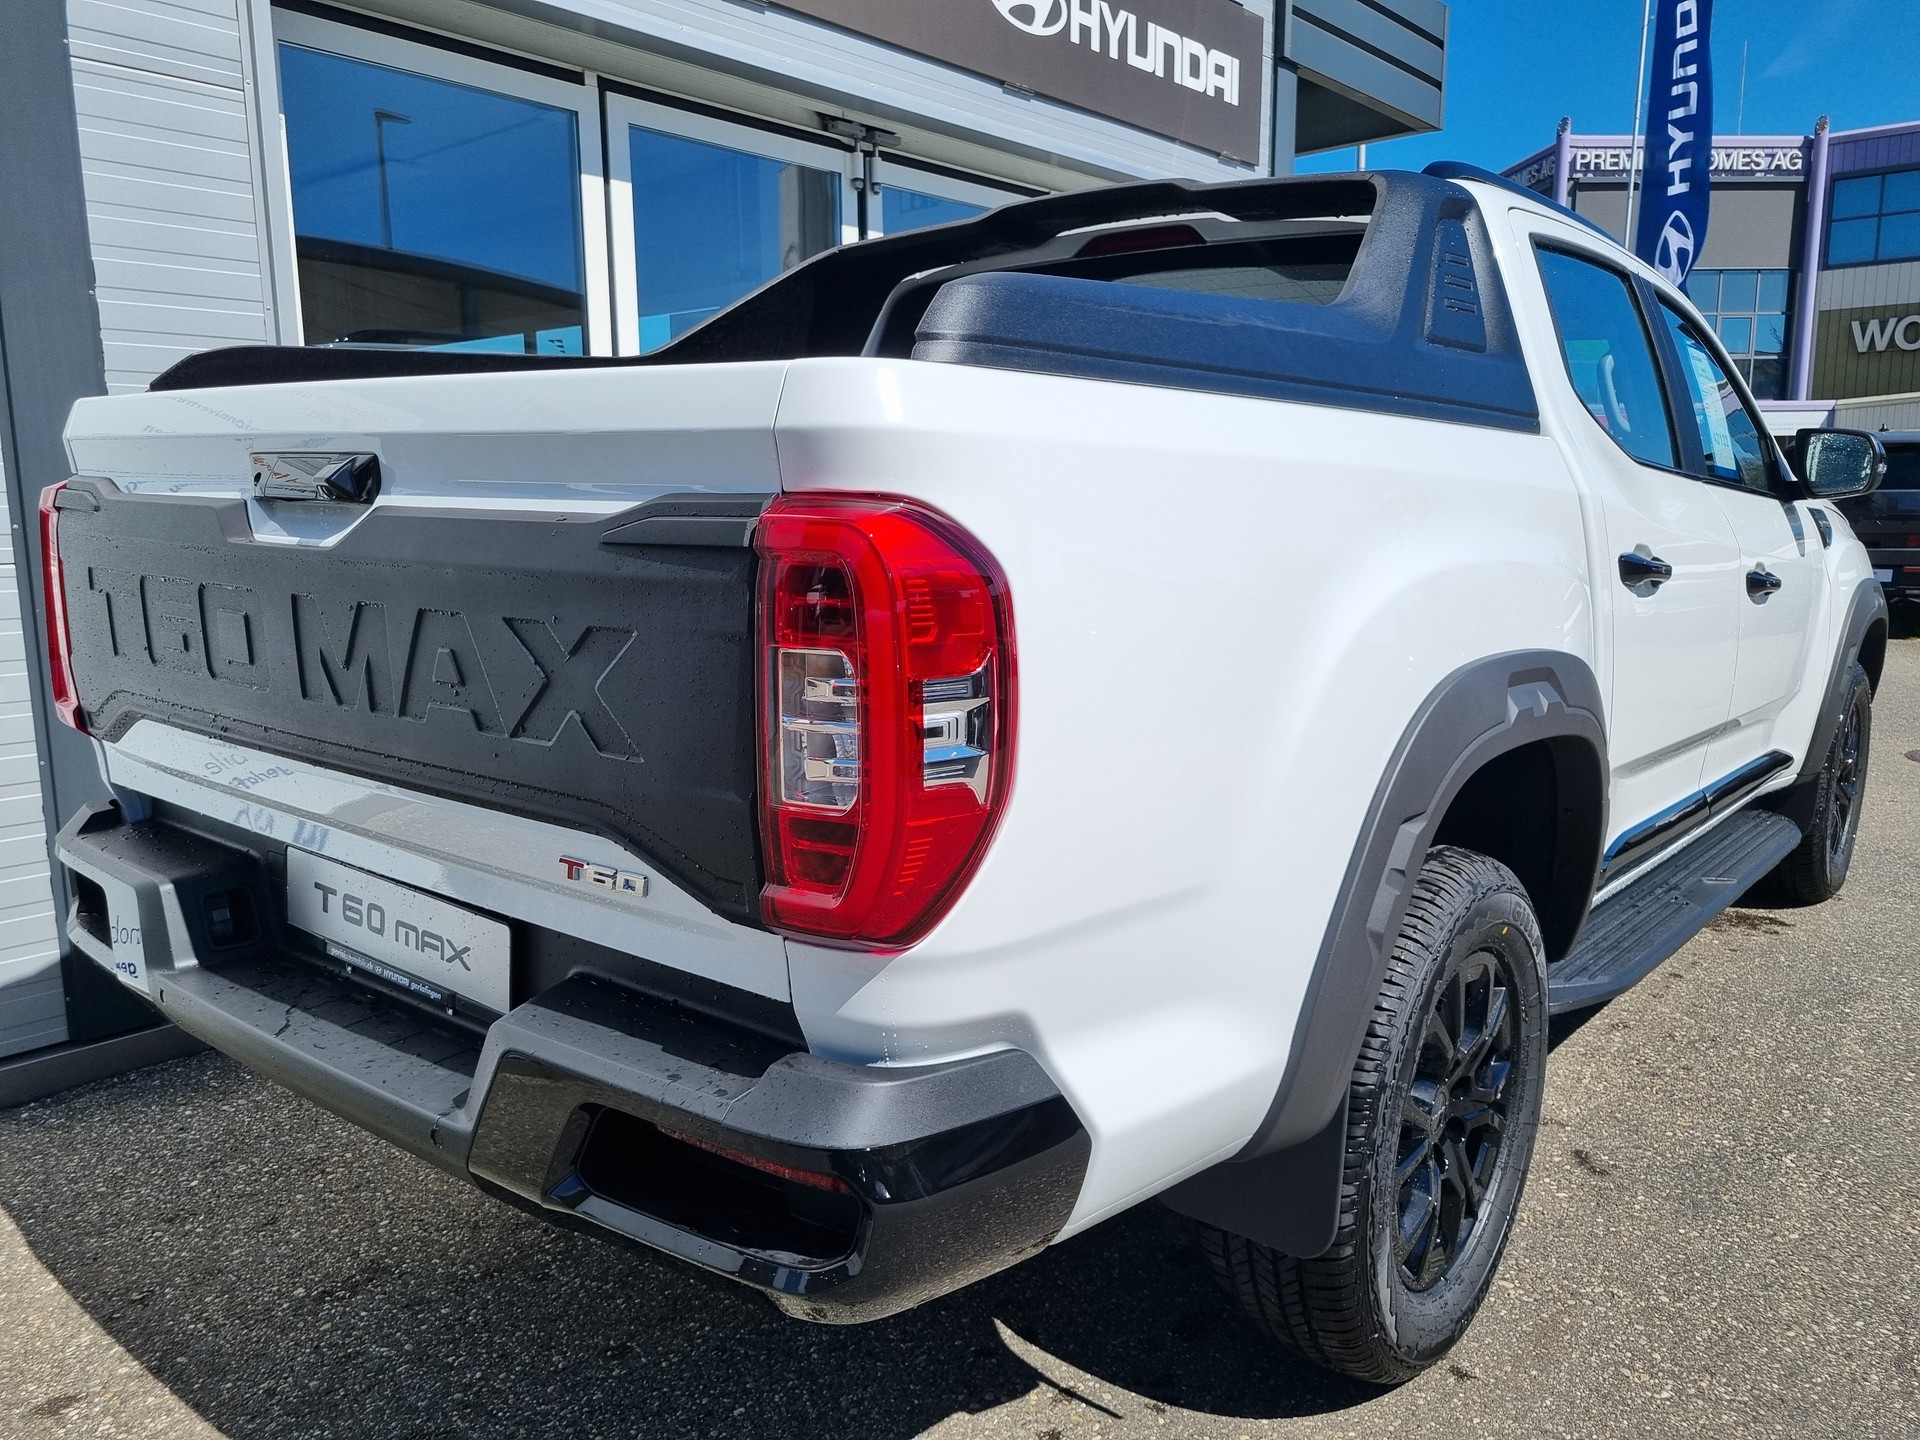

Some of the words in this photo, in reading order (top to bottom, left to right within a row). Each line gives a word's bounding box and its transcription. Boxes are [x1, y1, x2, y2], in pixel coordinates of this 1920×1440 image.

[1070, 0, 1240, 107] HYUNDAI
[1771, 149, 1803, 171] AG
[88, 565, 272, 694] T60
[290, 592, 645, 765] MAX
[558, 855, 649, 898] T60
[394, 919, 472, 972] MAX
[383, 968, 409, 987] HYUNDAI
